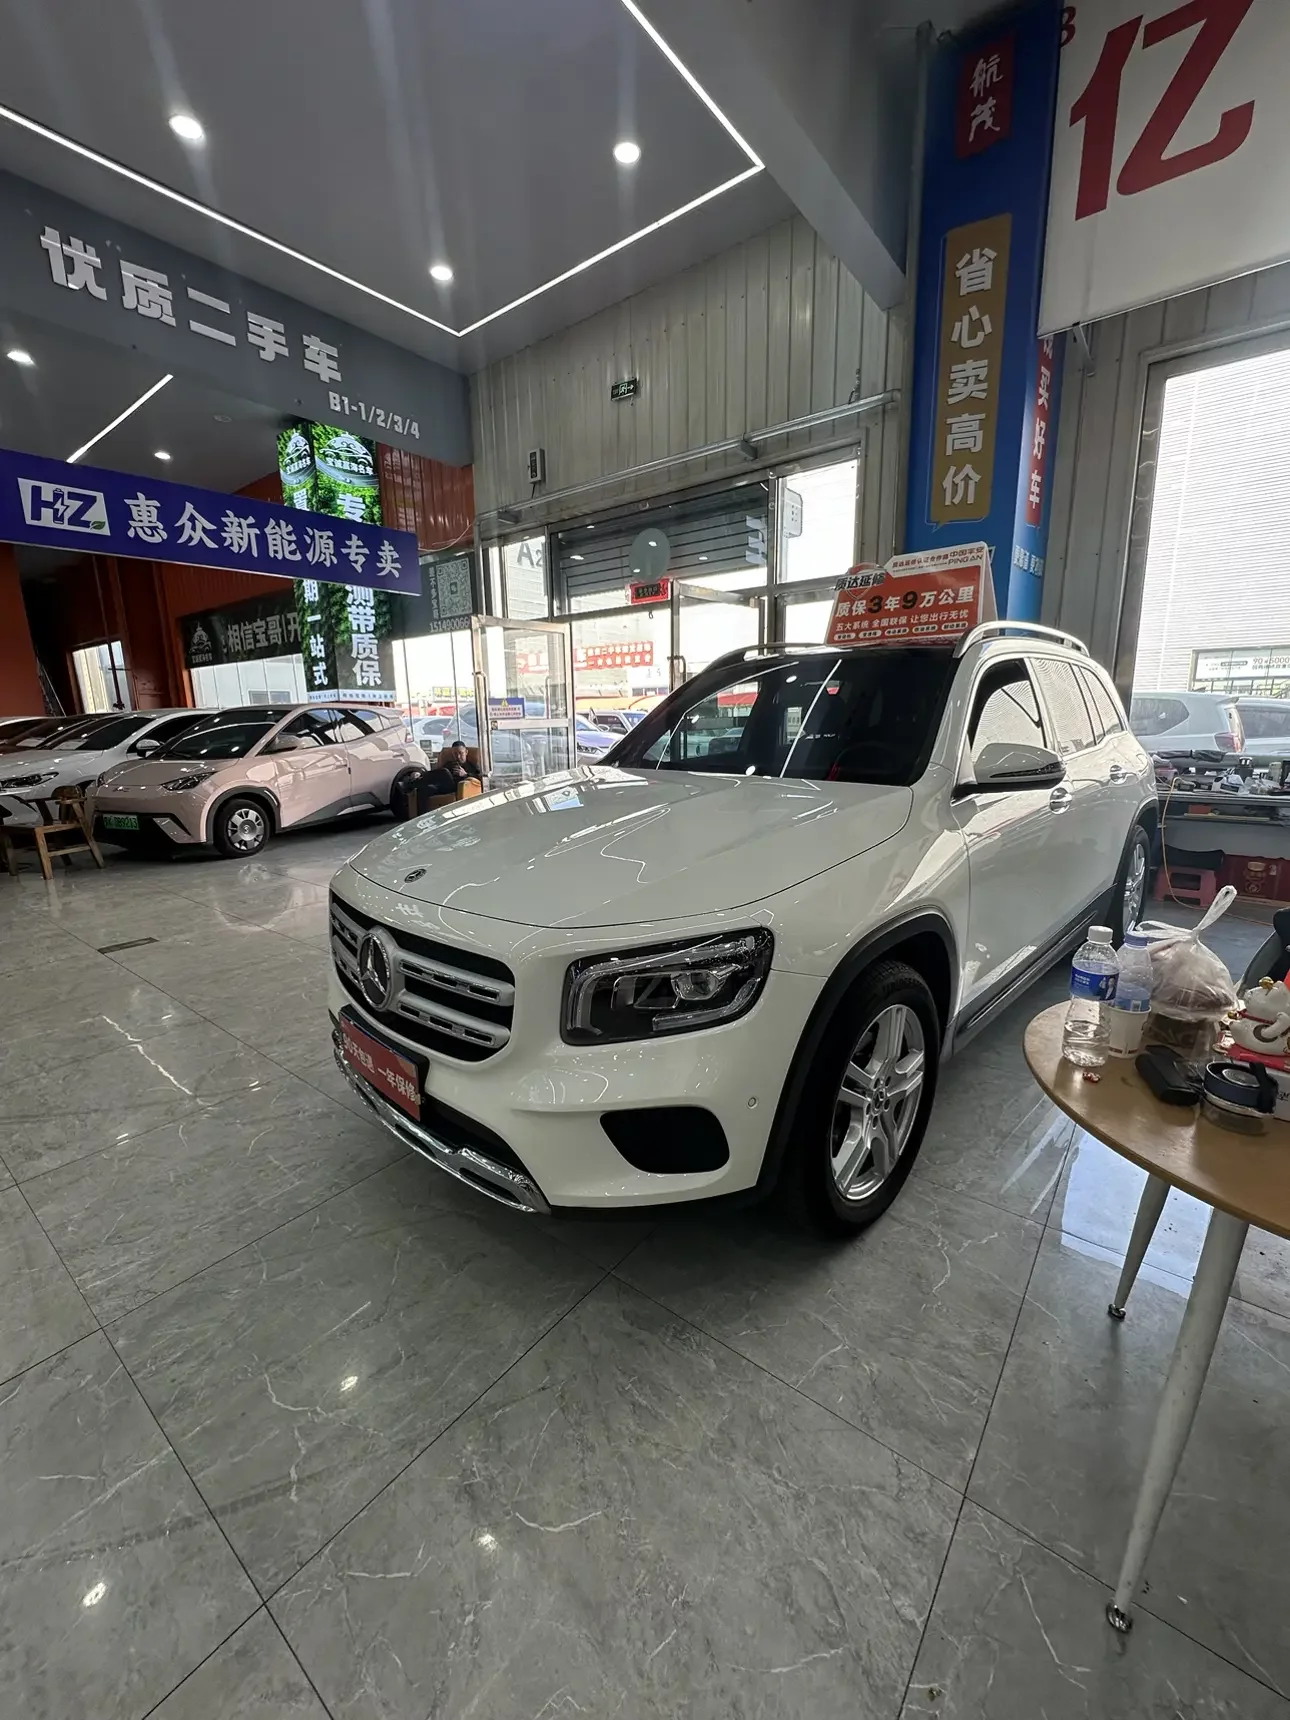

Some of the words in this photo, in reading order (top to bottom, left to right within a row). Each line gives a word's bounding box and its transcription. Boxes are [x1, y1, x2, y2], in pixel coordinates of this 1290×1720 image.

[968, 54, 1004, 143] 航茂
[1069, 0, 1256, 220] 亿
[40, 225, 343, 384] 优质二手车
[942, 247, 998, 507] 省心卖高价
[328, 391, 421, 440] B1-1/2/3/4
[31, 484, 98, 528] HZ
[124, 493, 403, 579] 惠众新能源专卖
[834, 572, 885, 591] 质达延修
[835, 585, 975, 618] 质保3年9万公里
[345, 584, 382, 687] 测带质保
[835, 621, 869, 631] 五大系统
[872, 616, 907, 628] 全国联保
[910, 609, 969, 624] 让您出行无忧
[378, 1067, 418, 1105] 一年保修
